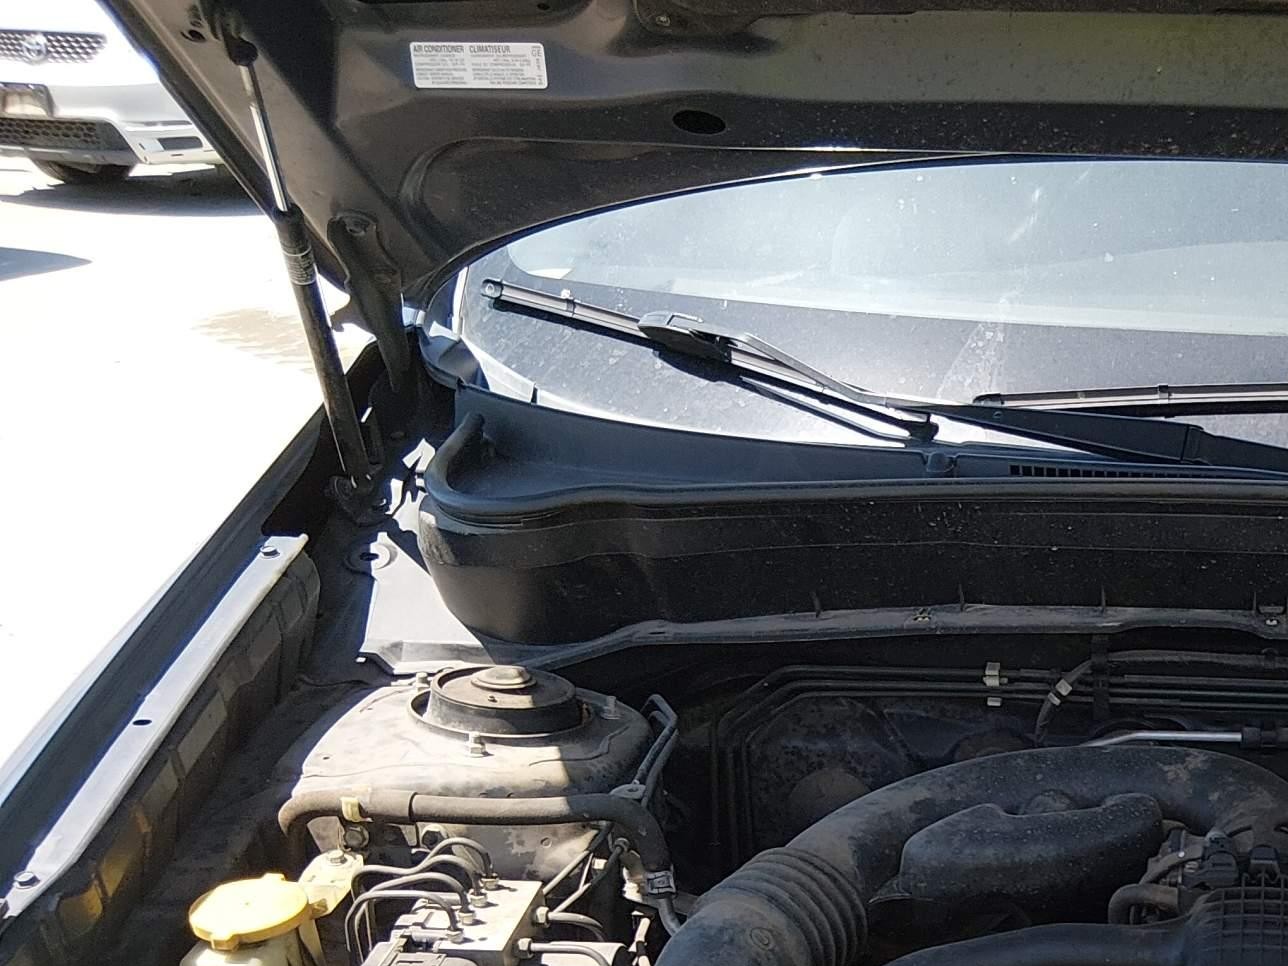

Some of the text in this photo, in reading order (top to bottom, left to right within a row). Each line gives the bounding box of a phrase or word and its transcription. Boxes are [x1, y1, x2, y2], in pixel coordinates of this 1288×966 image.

[413, 45, 511, 54] AIR CONDITIONER CLIMATISEUR
